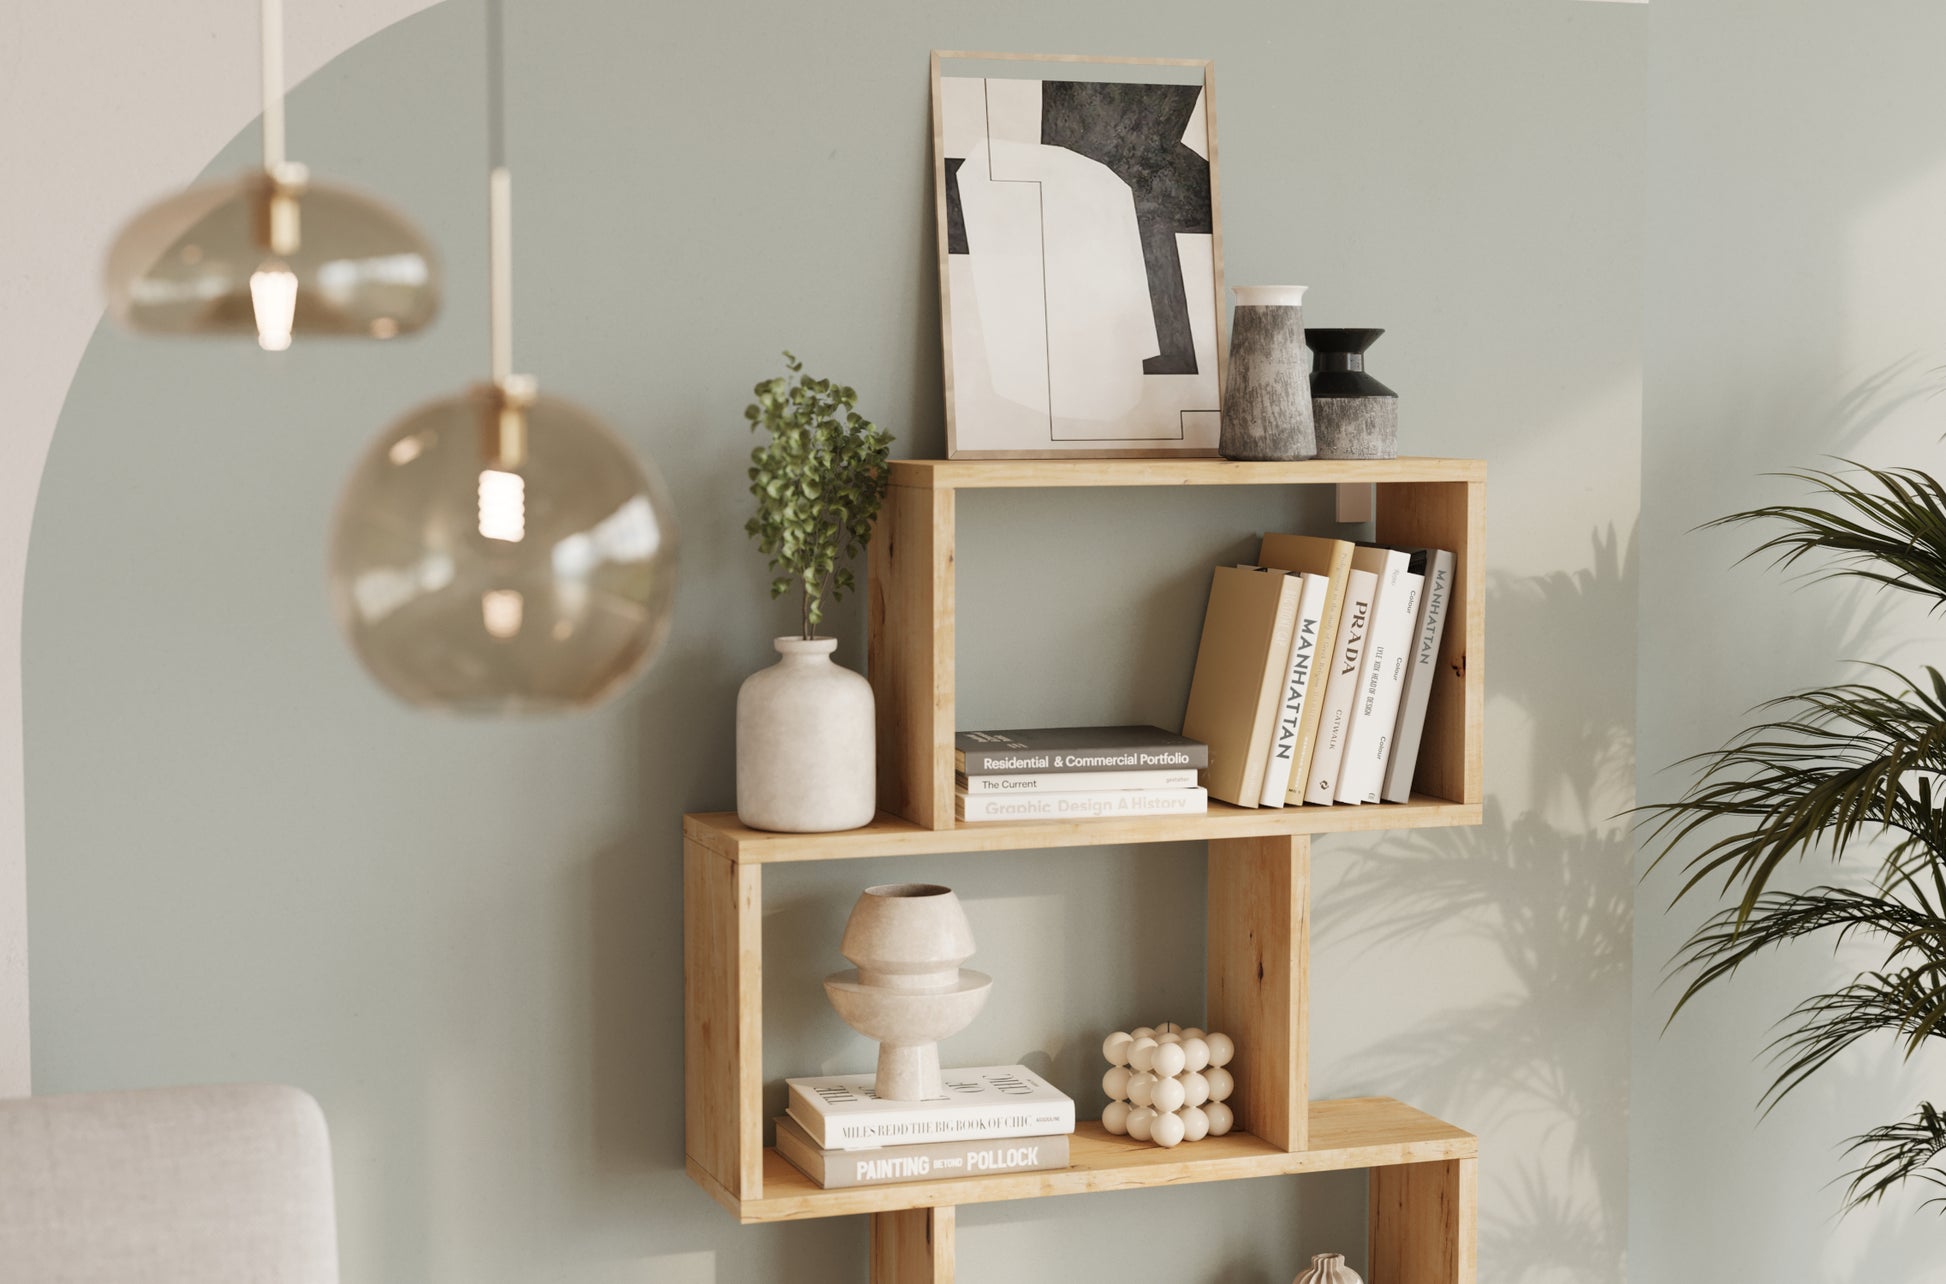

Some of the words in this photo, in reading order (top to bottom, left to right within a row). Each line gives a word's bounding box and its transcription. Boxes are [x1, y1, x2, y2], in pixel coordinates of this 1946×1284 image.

[1407, 590, 1416, 614] Colour
[1420, 569, 1447, 664] MANHATTAN
[1342, 601, 1368, 675] PRADA
[1393, 657, 1402, 680] Colour
[1276, 619, 1317, 760] MANHATTAN
[1364, 696, 1374, 716] DESIGN
[1329, 709, 1343, 750] CATWALK
[1376, 736, 1386, 760] Colour
[983, 755, 1049, 770] Residential
[1054, 755, 1063, 768] &
[1065, 753, 1137, 767] Commercial
[1140, 752, 1189, 765] Portfolio
[982, 780, 999, 789] The
[1001, 779, 1037, 789] Current
[1058, 798, 1113, 816] Design
[842, 1125, 876, 1139] MILES
[878, 1122, 909, 1136] REDD
[911, 1120, 934, 1134] THE
[935, 1120, 954, 1133] BIG
[956, 1118, 986, 1131] BOOK
[1004, 1114, 1033, 1128] CHIC
[856, 1156, 930, 1181] PAINTING
[966, 1146, 1039, 1171] POLLOCK
